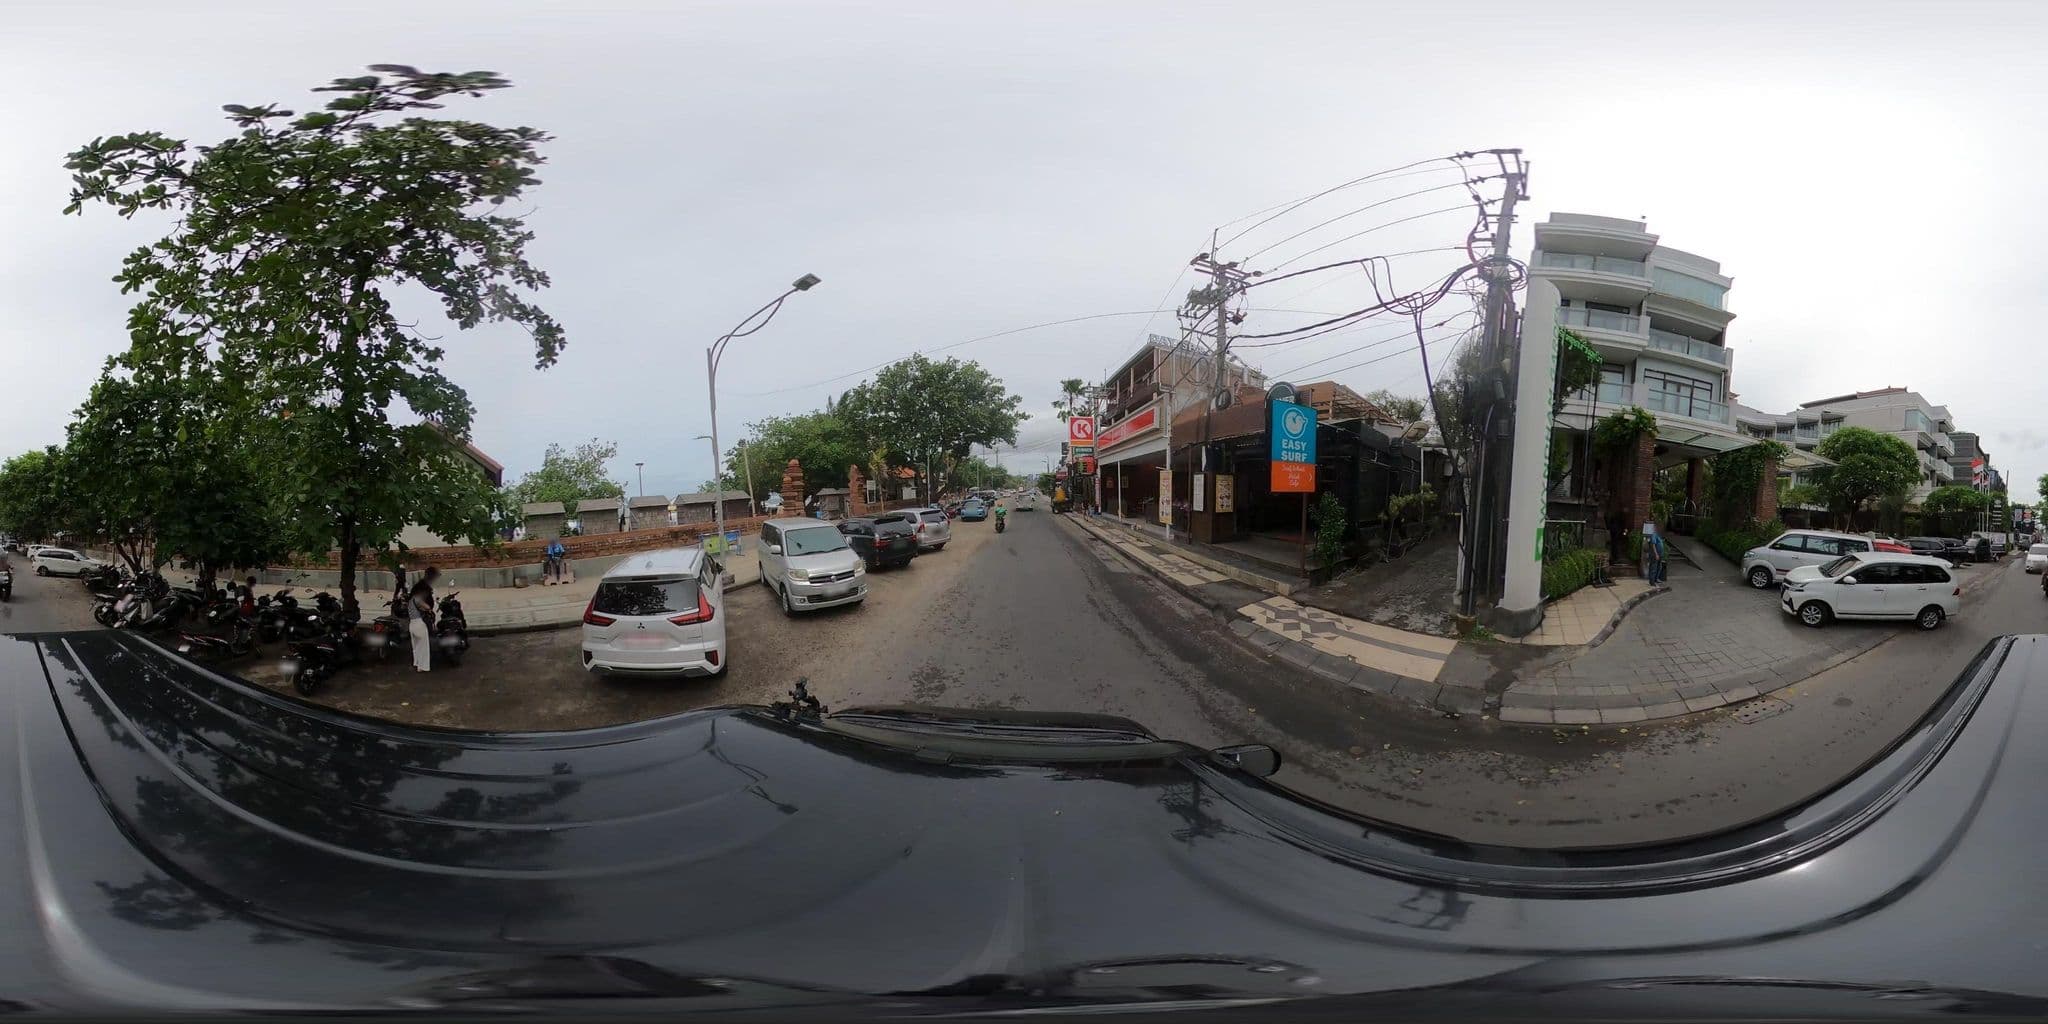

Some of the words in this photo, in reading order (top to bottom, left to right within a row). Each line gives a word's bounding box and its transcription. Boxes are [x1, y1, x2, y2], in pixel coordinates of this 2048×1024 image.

[1077, 423, 1089, 437] K
[1281, 438, 1307, 451] EASY
[1281, 450, 1308, 462] SURF
